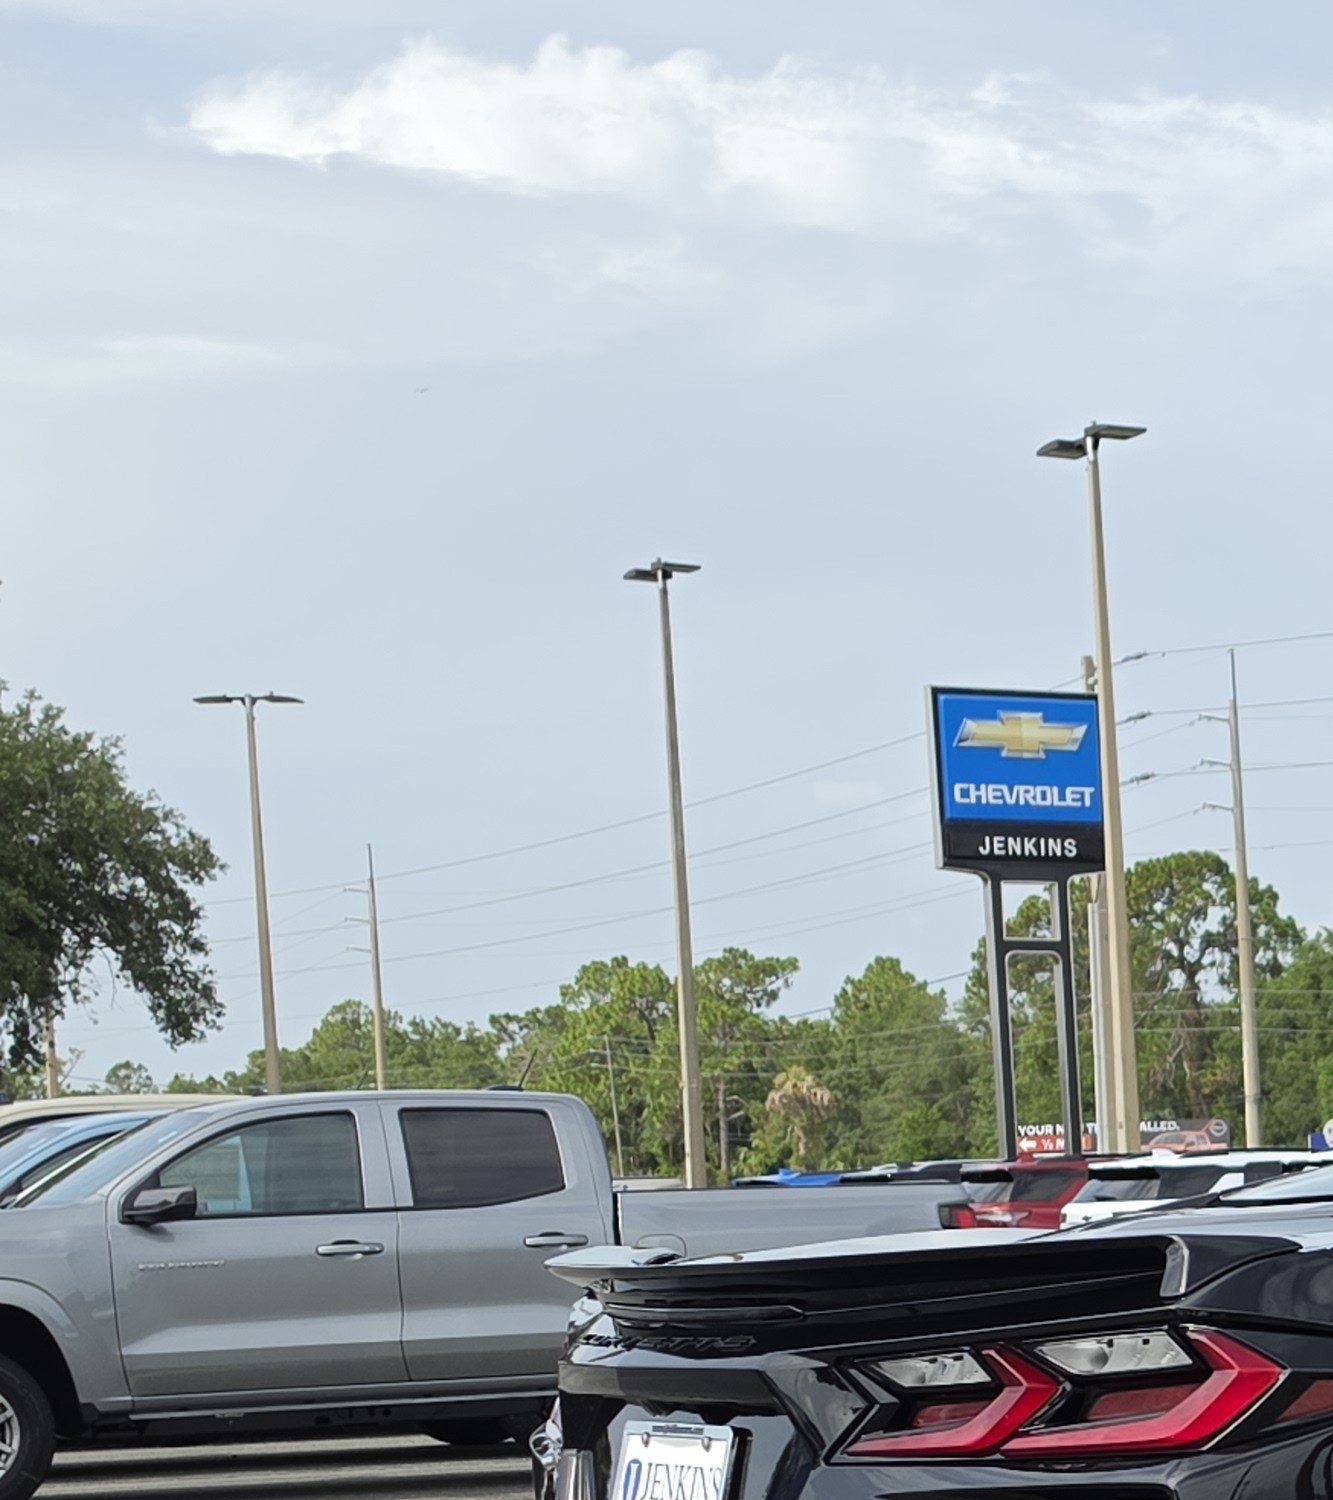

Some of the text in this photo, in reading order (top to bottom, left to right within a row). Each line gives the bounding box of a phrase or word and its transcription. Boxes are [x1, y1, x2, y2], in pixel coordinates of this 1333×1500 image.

[954, 782, 1095, 808] CHEVROLET
[978, 835, 1078, 858] JENKINS
[1018, 1124, 1053, 1136] YOUR
